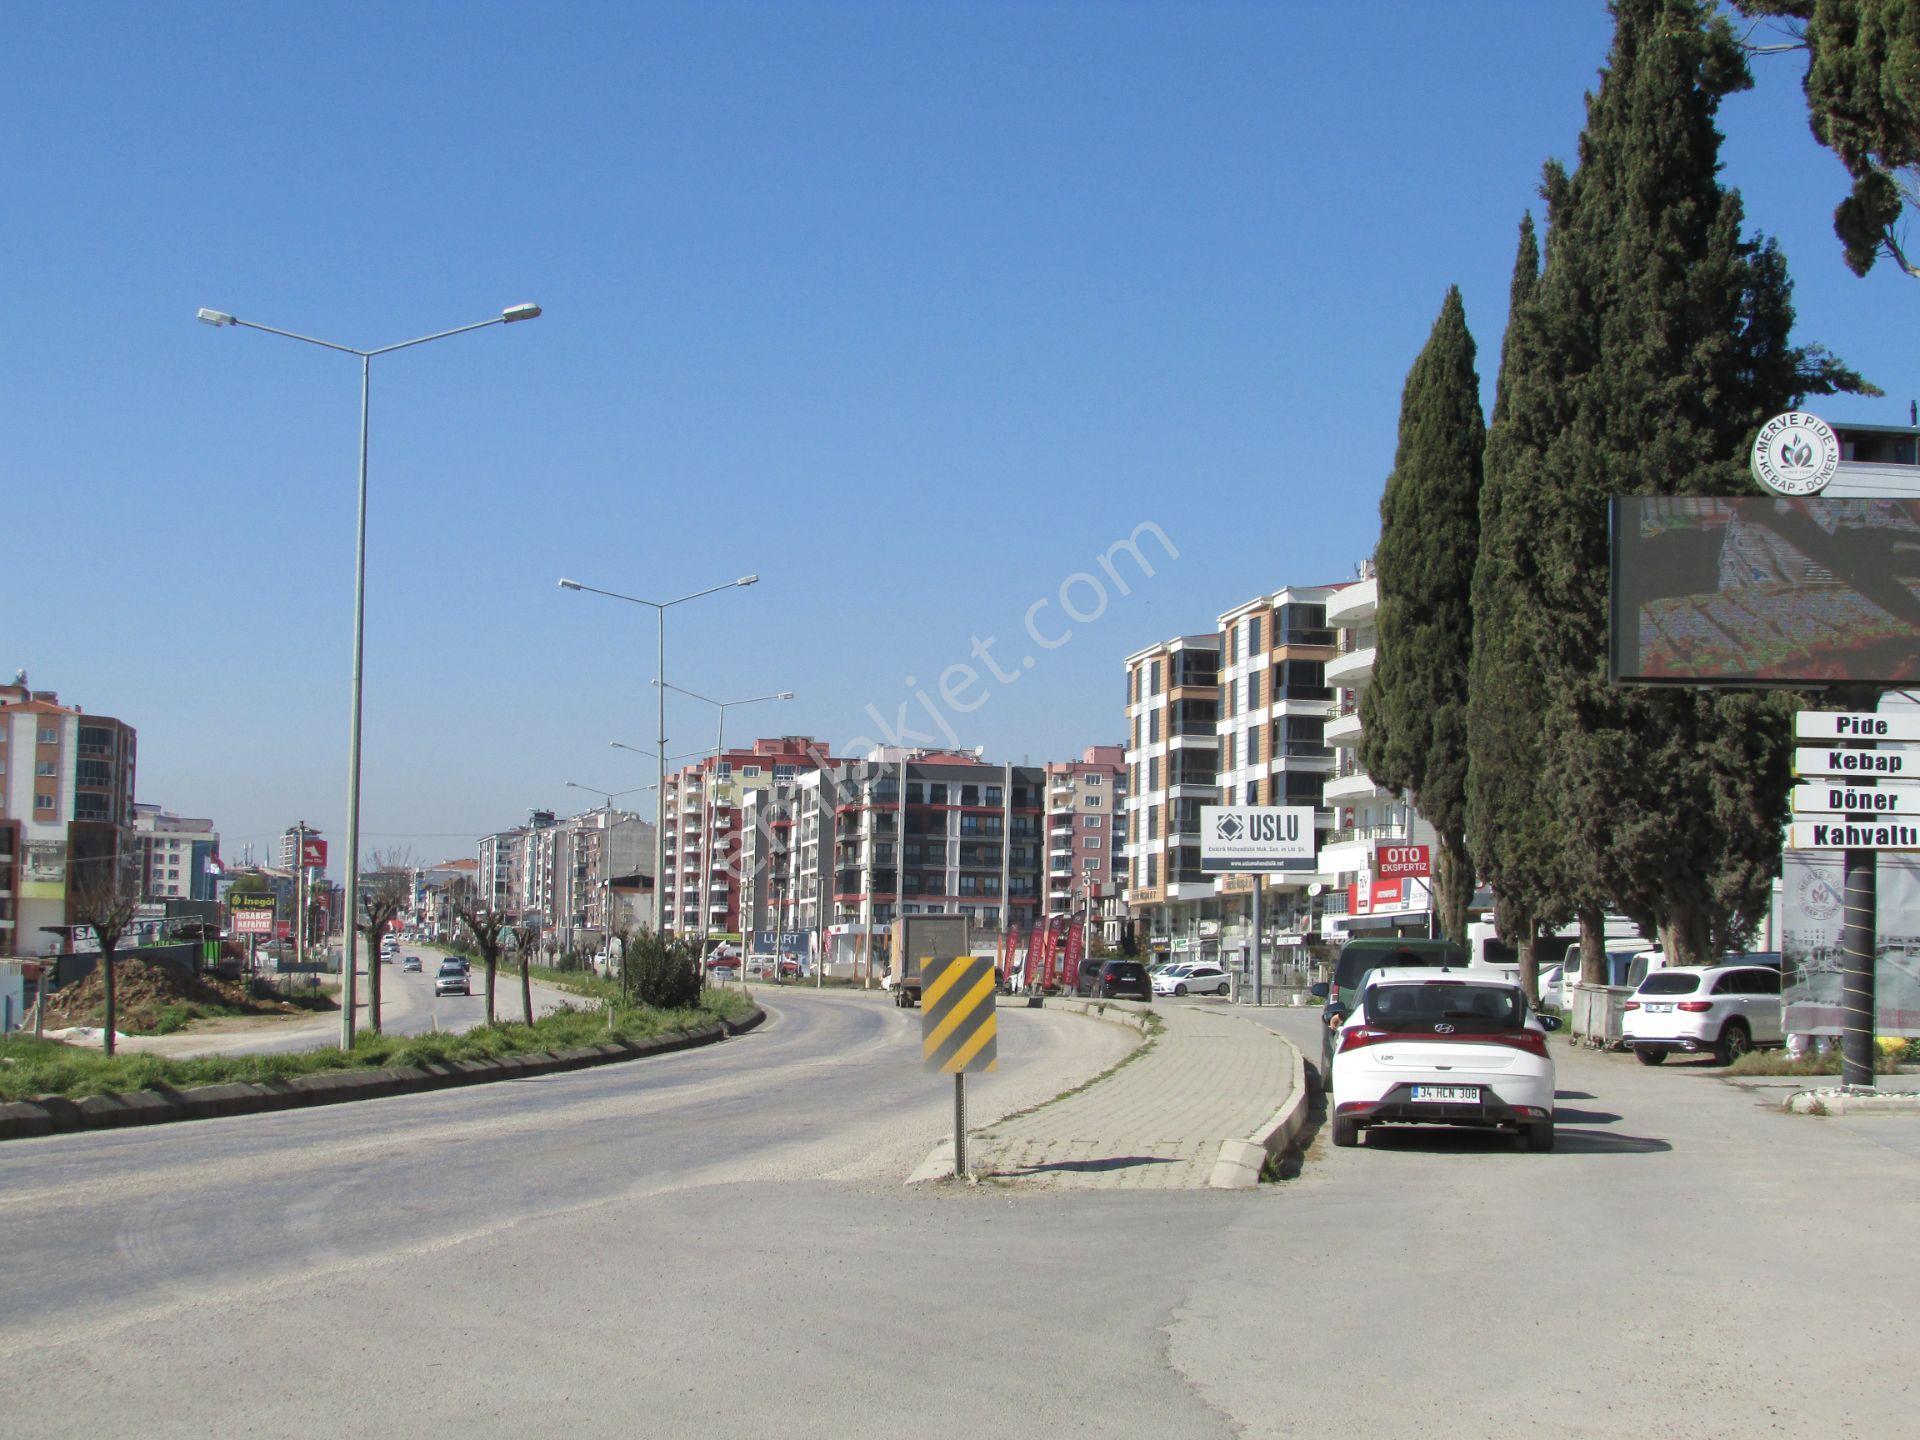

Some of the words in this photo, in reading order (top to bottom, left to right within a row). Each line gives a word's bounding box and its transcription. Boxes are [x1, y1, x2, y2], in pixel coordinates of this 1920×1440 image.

[1757, 414, 1798, 453] MERVE
[1760, 461, 1795, 491] KEBAP
[1805, 454, 1837, 491] DÖNER
[1836, 716, 1888, 734] Pide
[1829, 751, 1902, 773] Kebap
[1829, 788, 1898, 810] Döner
[1250, 814, 1299, 841] USLU
[1814, 824, 1917, 845] Kahvaltı
[1387, 847, 1420, 863] OTO
[1420, 1087, 1432, 1098] 34
[1436, 1088, 1455, 1098] HCN
[1460, 1088, 1477, 1099] 308
